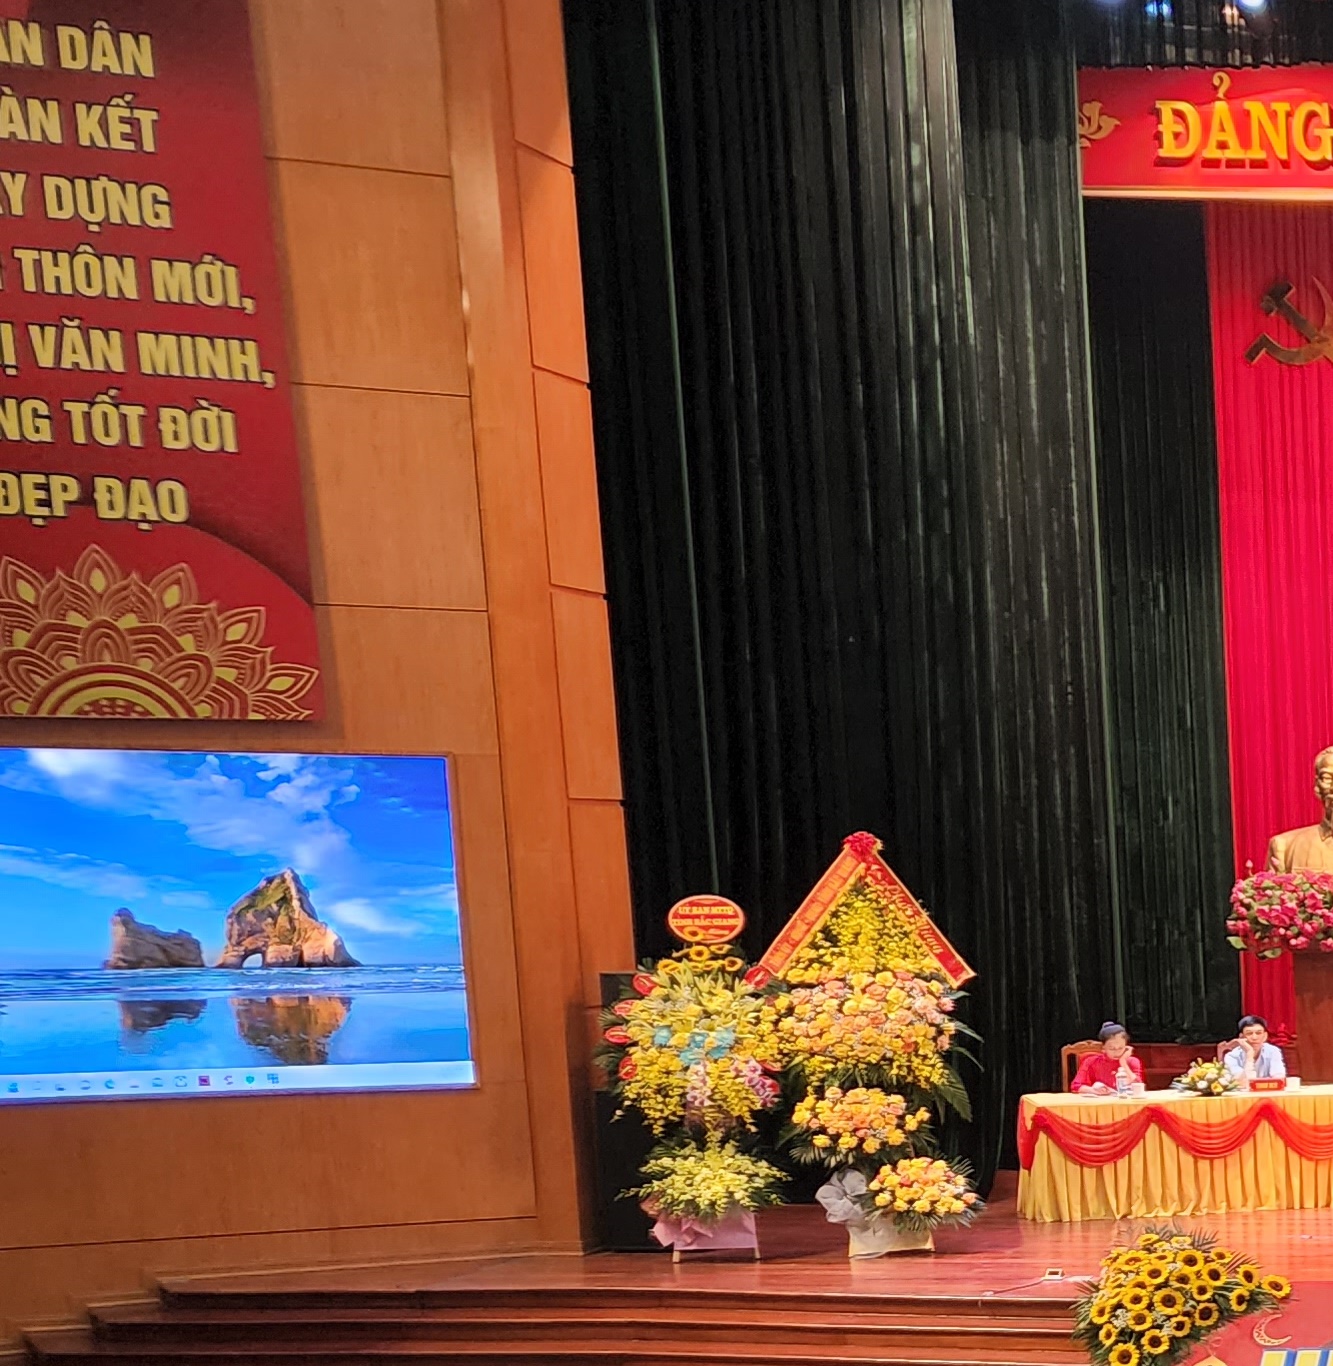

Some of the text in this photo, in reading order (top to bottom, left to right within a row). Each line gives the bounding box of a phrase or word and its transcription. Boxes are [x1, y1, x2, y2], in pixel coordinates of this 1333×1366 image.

[56, 20, 155, 78] DÂN
[75, 94, 158, 152] KẾT
[43, 175, 173, 232] DỰNG
[13, 244, 139, 300] THÔN
[152, 254, 257, 313] MỚI,
[28, 316, 275, 388] VĂN MINH,
[63, 388, 147, 446] TỐT
[159, 395, 238, 453] ĐỜI
[94, 476, 189, 530] ĐẠO
